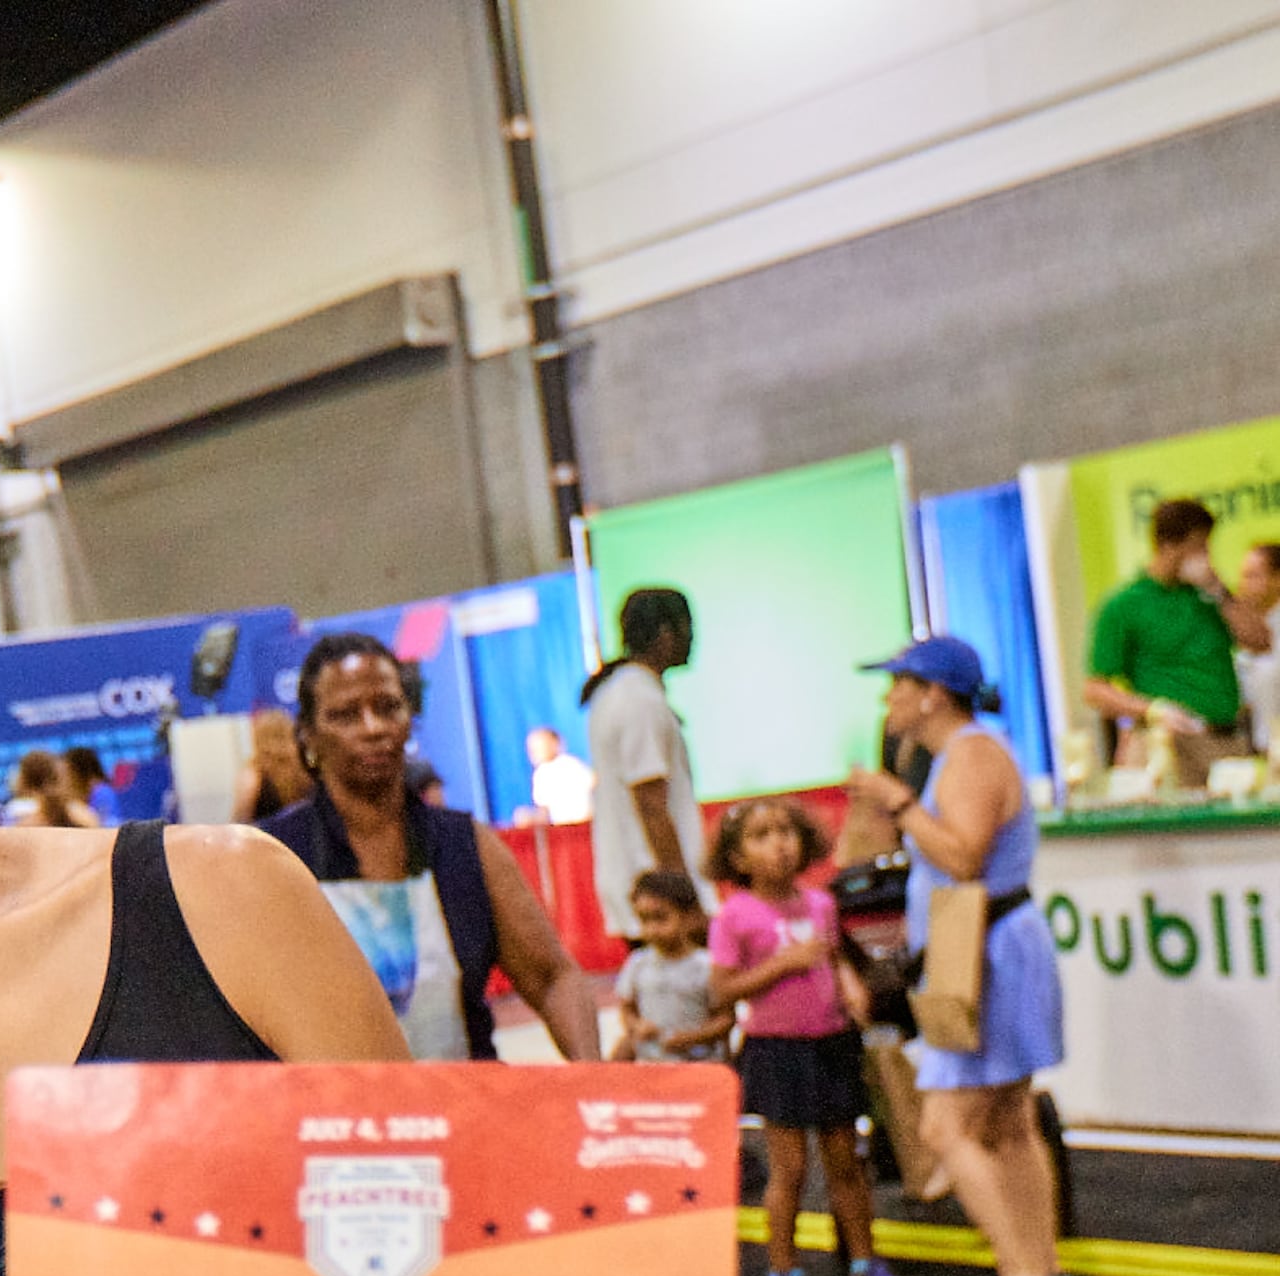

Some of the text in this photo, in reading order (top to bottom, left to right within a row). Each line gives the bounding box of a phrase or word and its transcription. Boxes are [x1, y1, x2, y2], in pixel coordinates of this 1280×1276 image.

[298, 1116, 353, 1142] JULY
[385, 1115, 450, 1142] 2024
[306, 1187, 441, 1208] PEACHTREE
